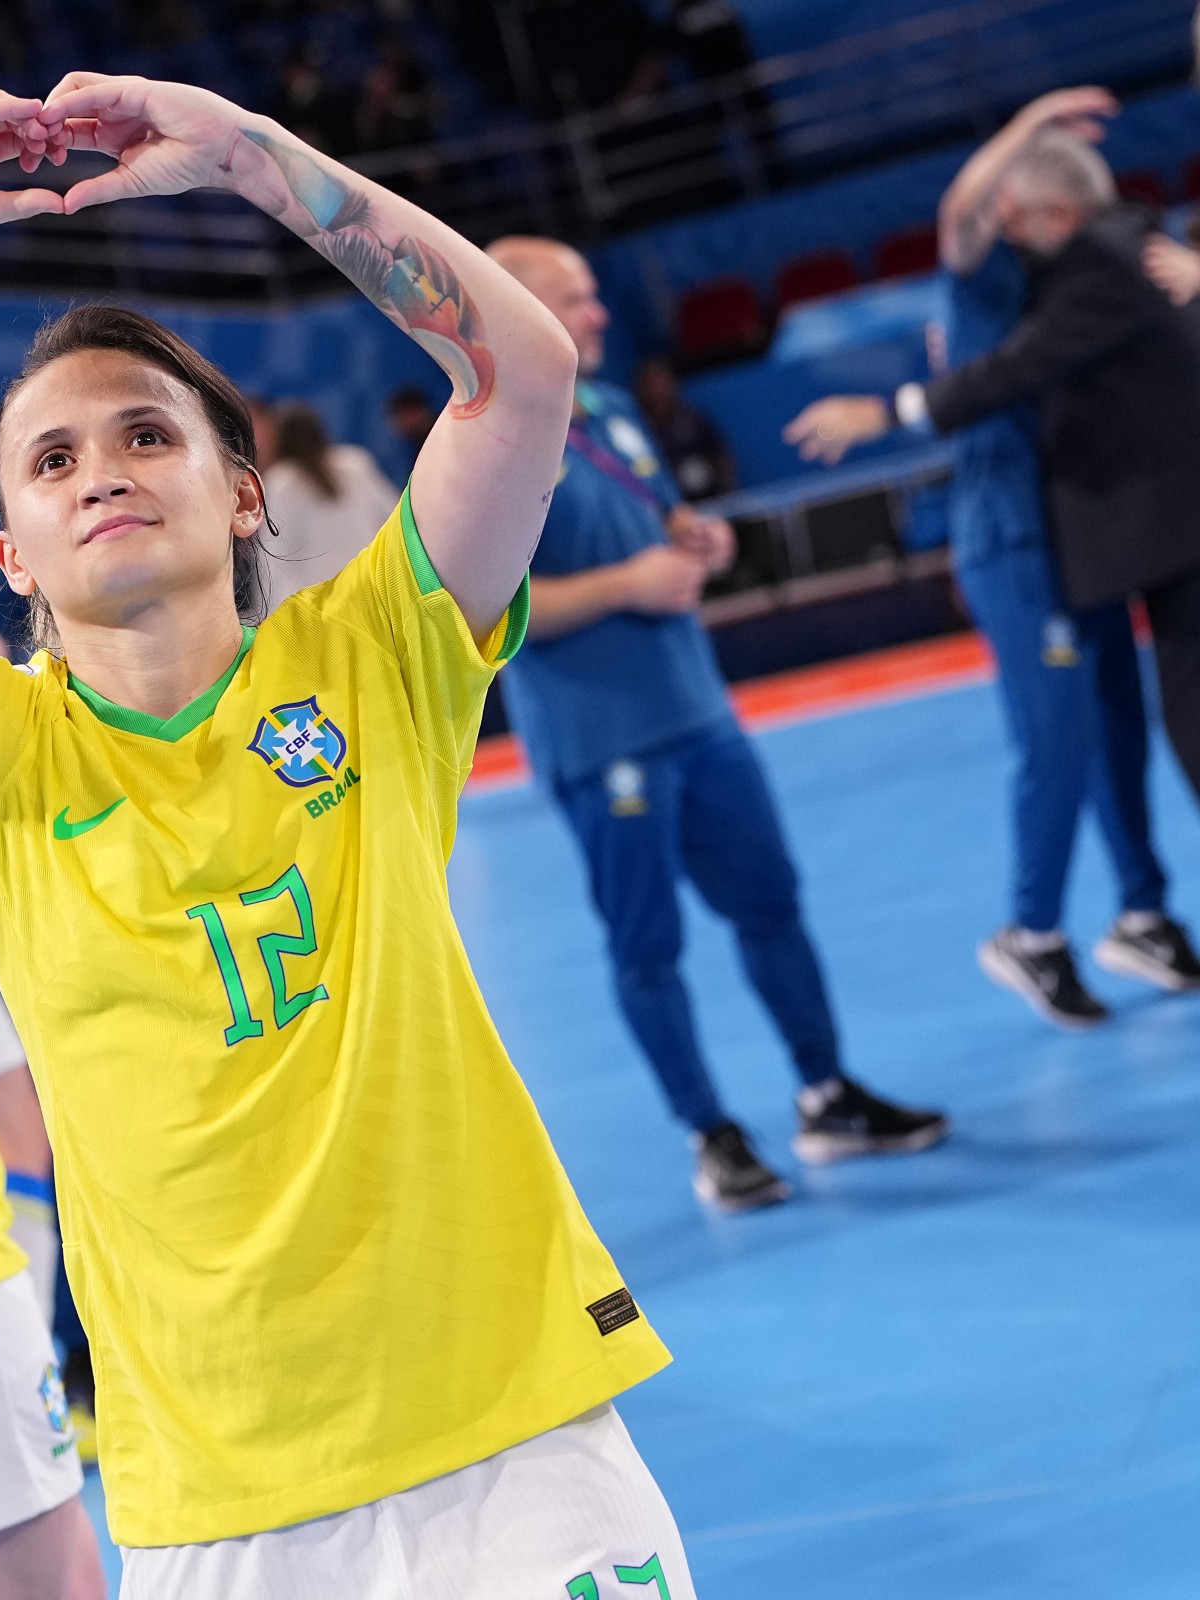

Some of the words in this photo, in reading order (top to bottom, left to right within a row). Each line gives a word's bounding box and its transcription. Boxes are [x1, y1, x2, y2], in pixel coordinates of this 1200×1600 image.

[284, 729, 312, 756] CBF
[304, 766, 361, 820] BRAIL
[185, 863, 330, 1047] 12
